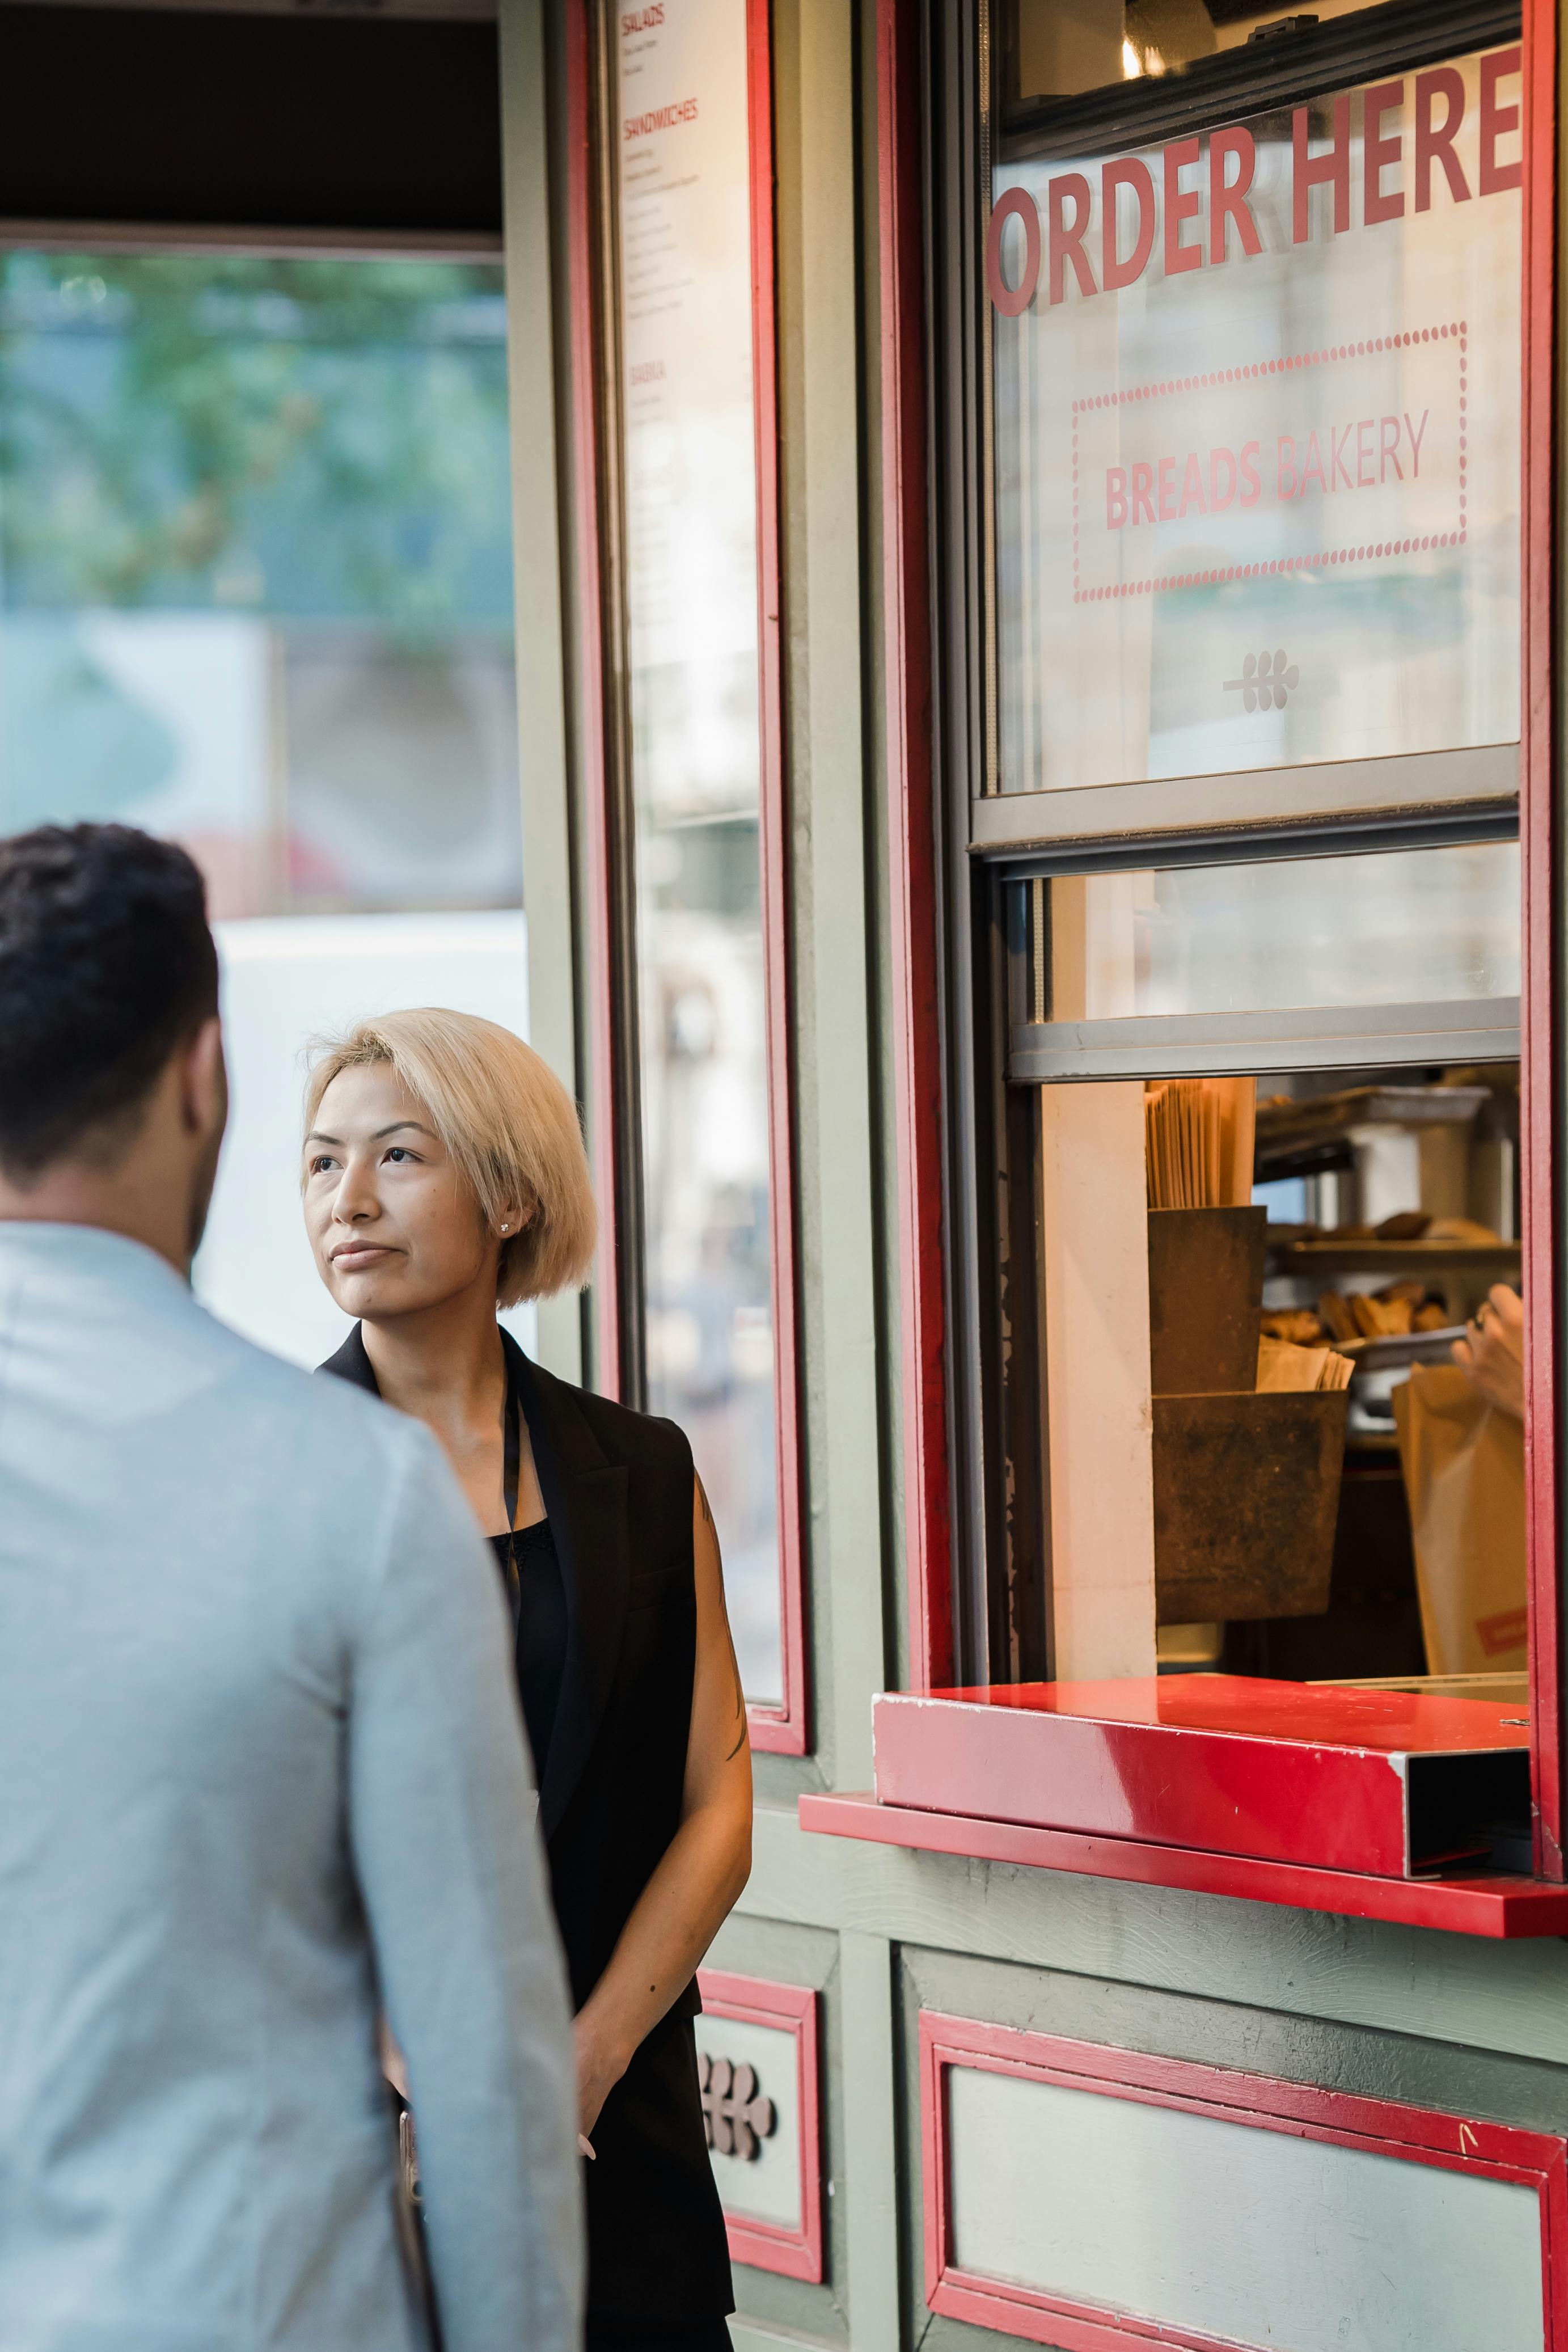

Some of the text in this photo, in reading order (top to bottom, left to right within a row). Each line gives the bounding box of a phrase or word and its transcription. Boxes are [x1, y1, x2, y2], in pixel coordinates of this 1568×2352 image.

[624, 98, 698, 141] SANDWICHES
[987, 46, 1522, 317] ORDER HERE
[1106, 409, 1429, 530] BREADS BAKERY
